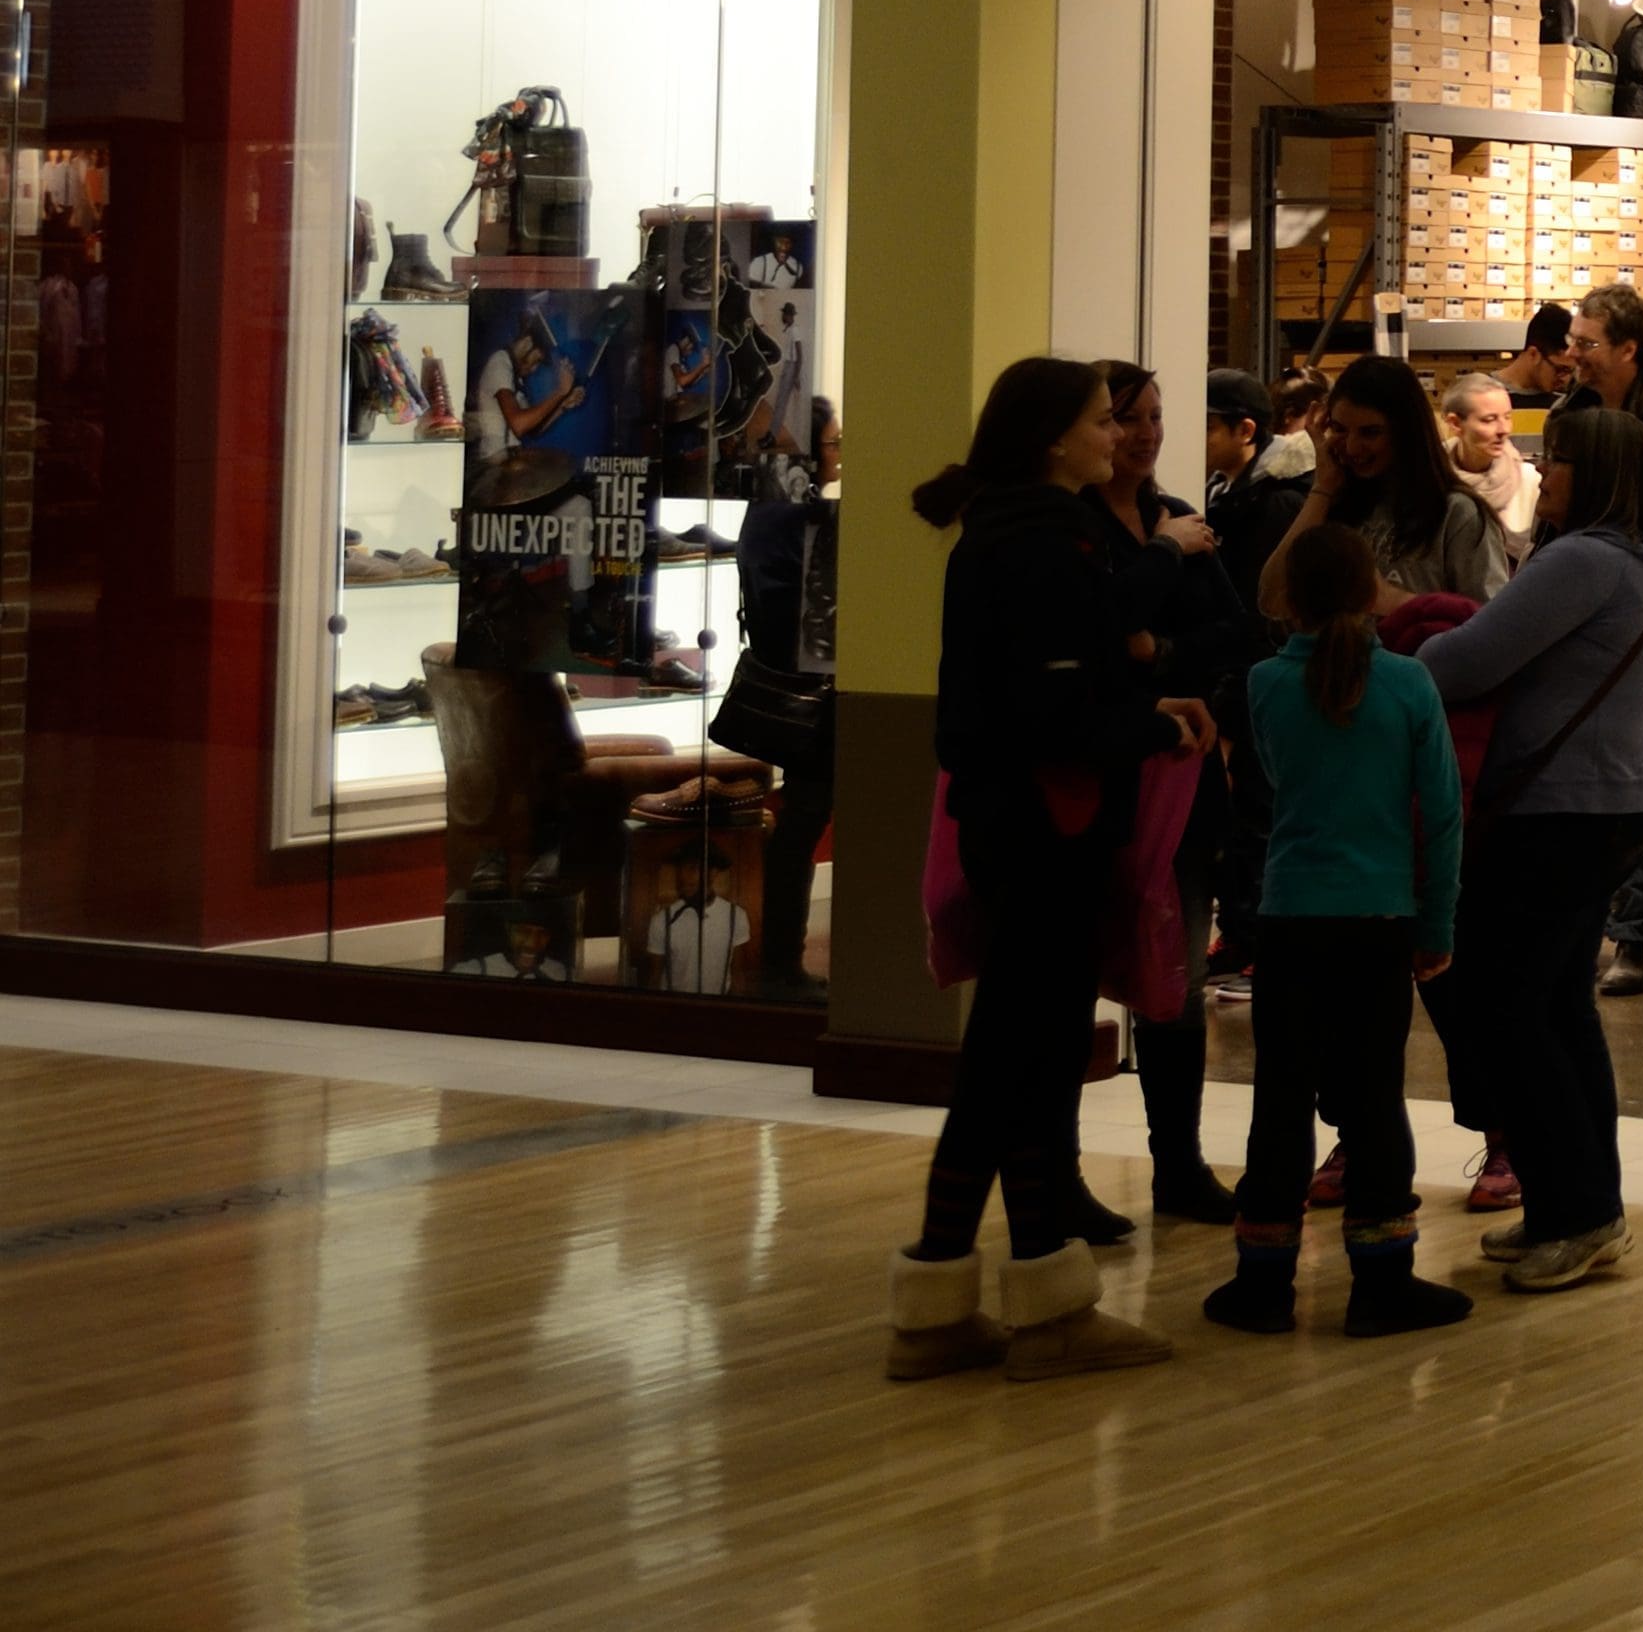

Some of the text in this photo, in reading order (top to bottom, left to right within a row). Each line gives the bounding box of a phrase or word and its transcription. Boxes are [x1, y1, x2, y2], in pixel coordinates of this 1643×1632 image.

[583, 456, 650, 473] ACHIEVING
[596, 476, 648, 517] THE
[471, 512, 646, 558] UNEXPECTED
